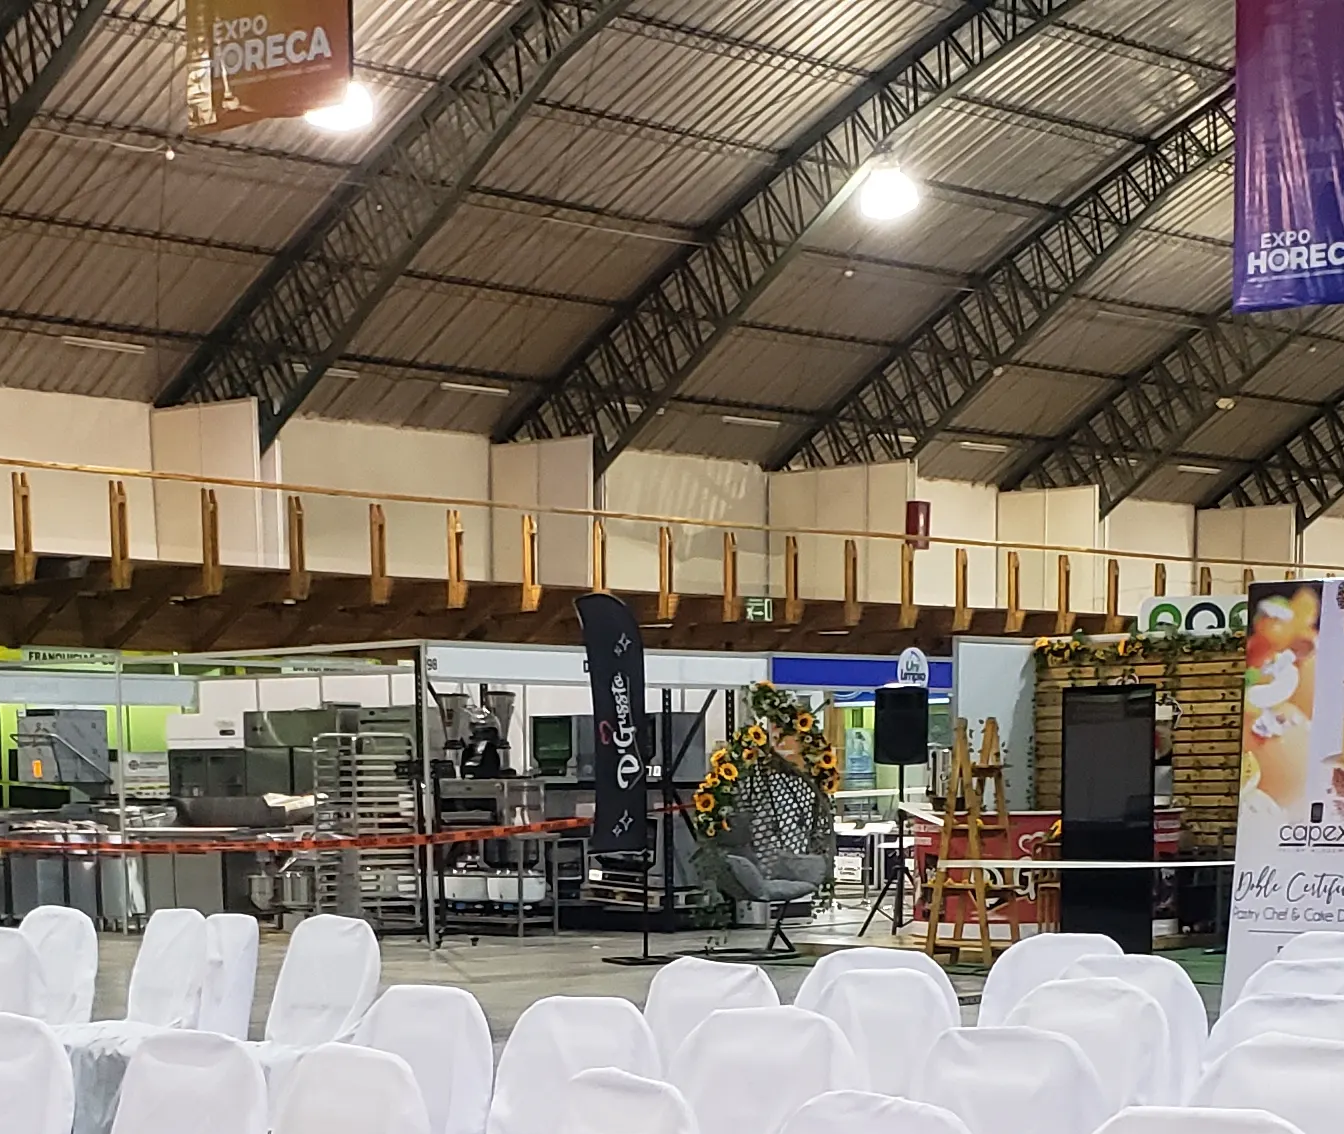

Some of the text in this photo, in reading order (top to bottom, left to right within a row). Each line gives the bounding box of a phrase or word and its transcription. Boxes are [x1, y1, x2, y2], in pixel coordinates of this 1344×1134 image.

[212, 14, 268, 42] EXPO
[210, 26, 333, 78] HORECA
[1260, 229, 1311, 249] EXPO
[426, 658, 438, 671] 98
[1233, 865, 1282, 902] Doble
[1262, 906, 1288, 921] Chef
[1303, 908, 1334, 923] Cake
